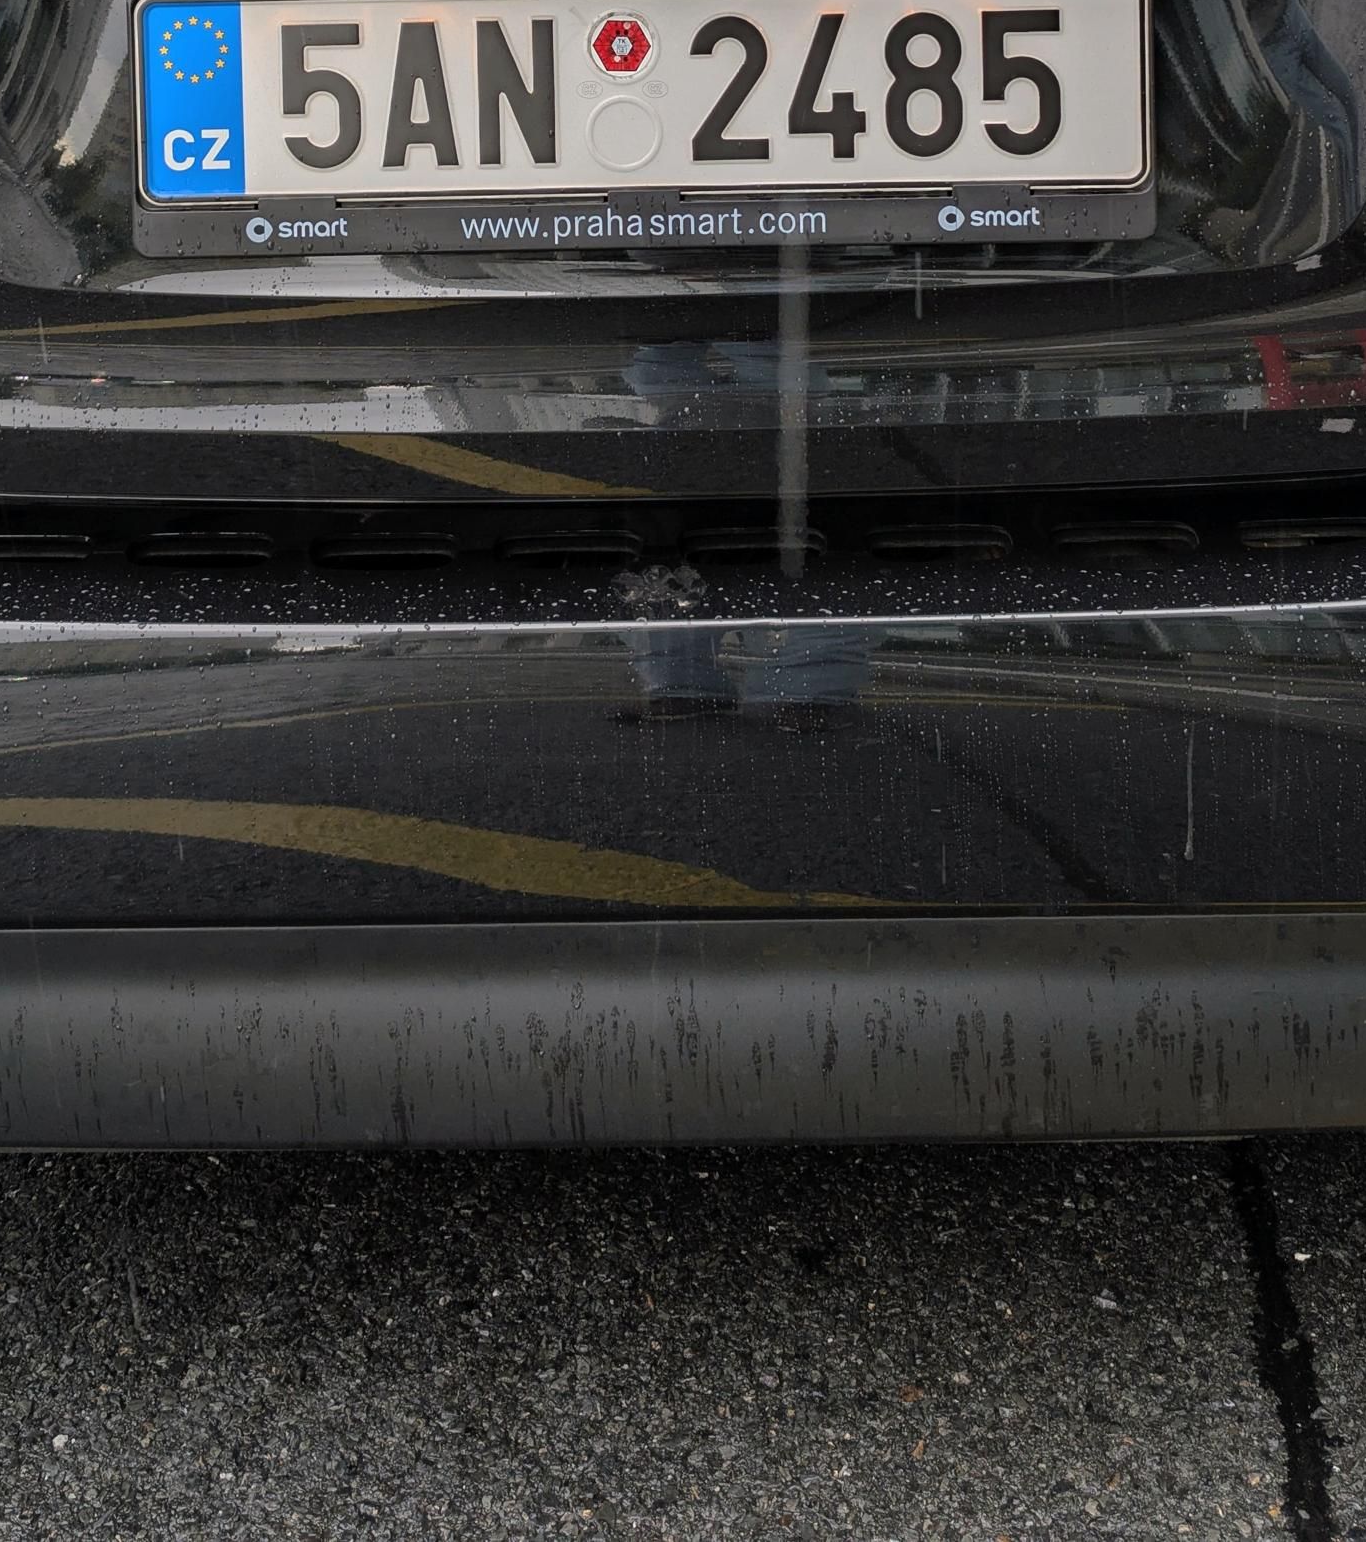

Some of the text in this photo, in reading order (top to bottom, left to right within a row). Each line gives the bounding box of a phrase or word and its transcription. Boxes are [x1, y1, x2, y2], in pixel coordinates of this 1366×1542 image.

[282, 9, 1062, 169] 5AN 2485
[163, 129, 231, 171] CZ
[277, 206, 1041, 245] smart www.prahasmart.com smart
